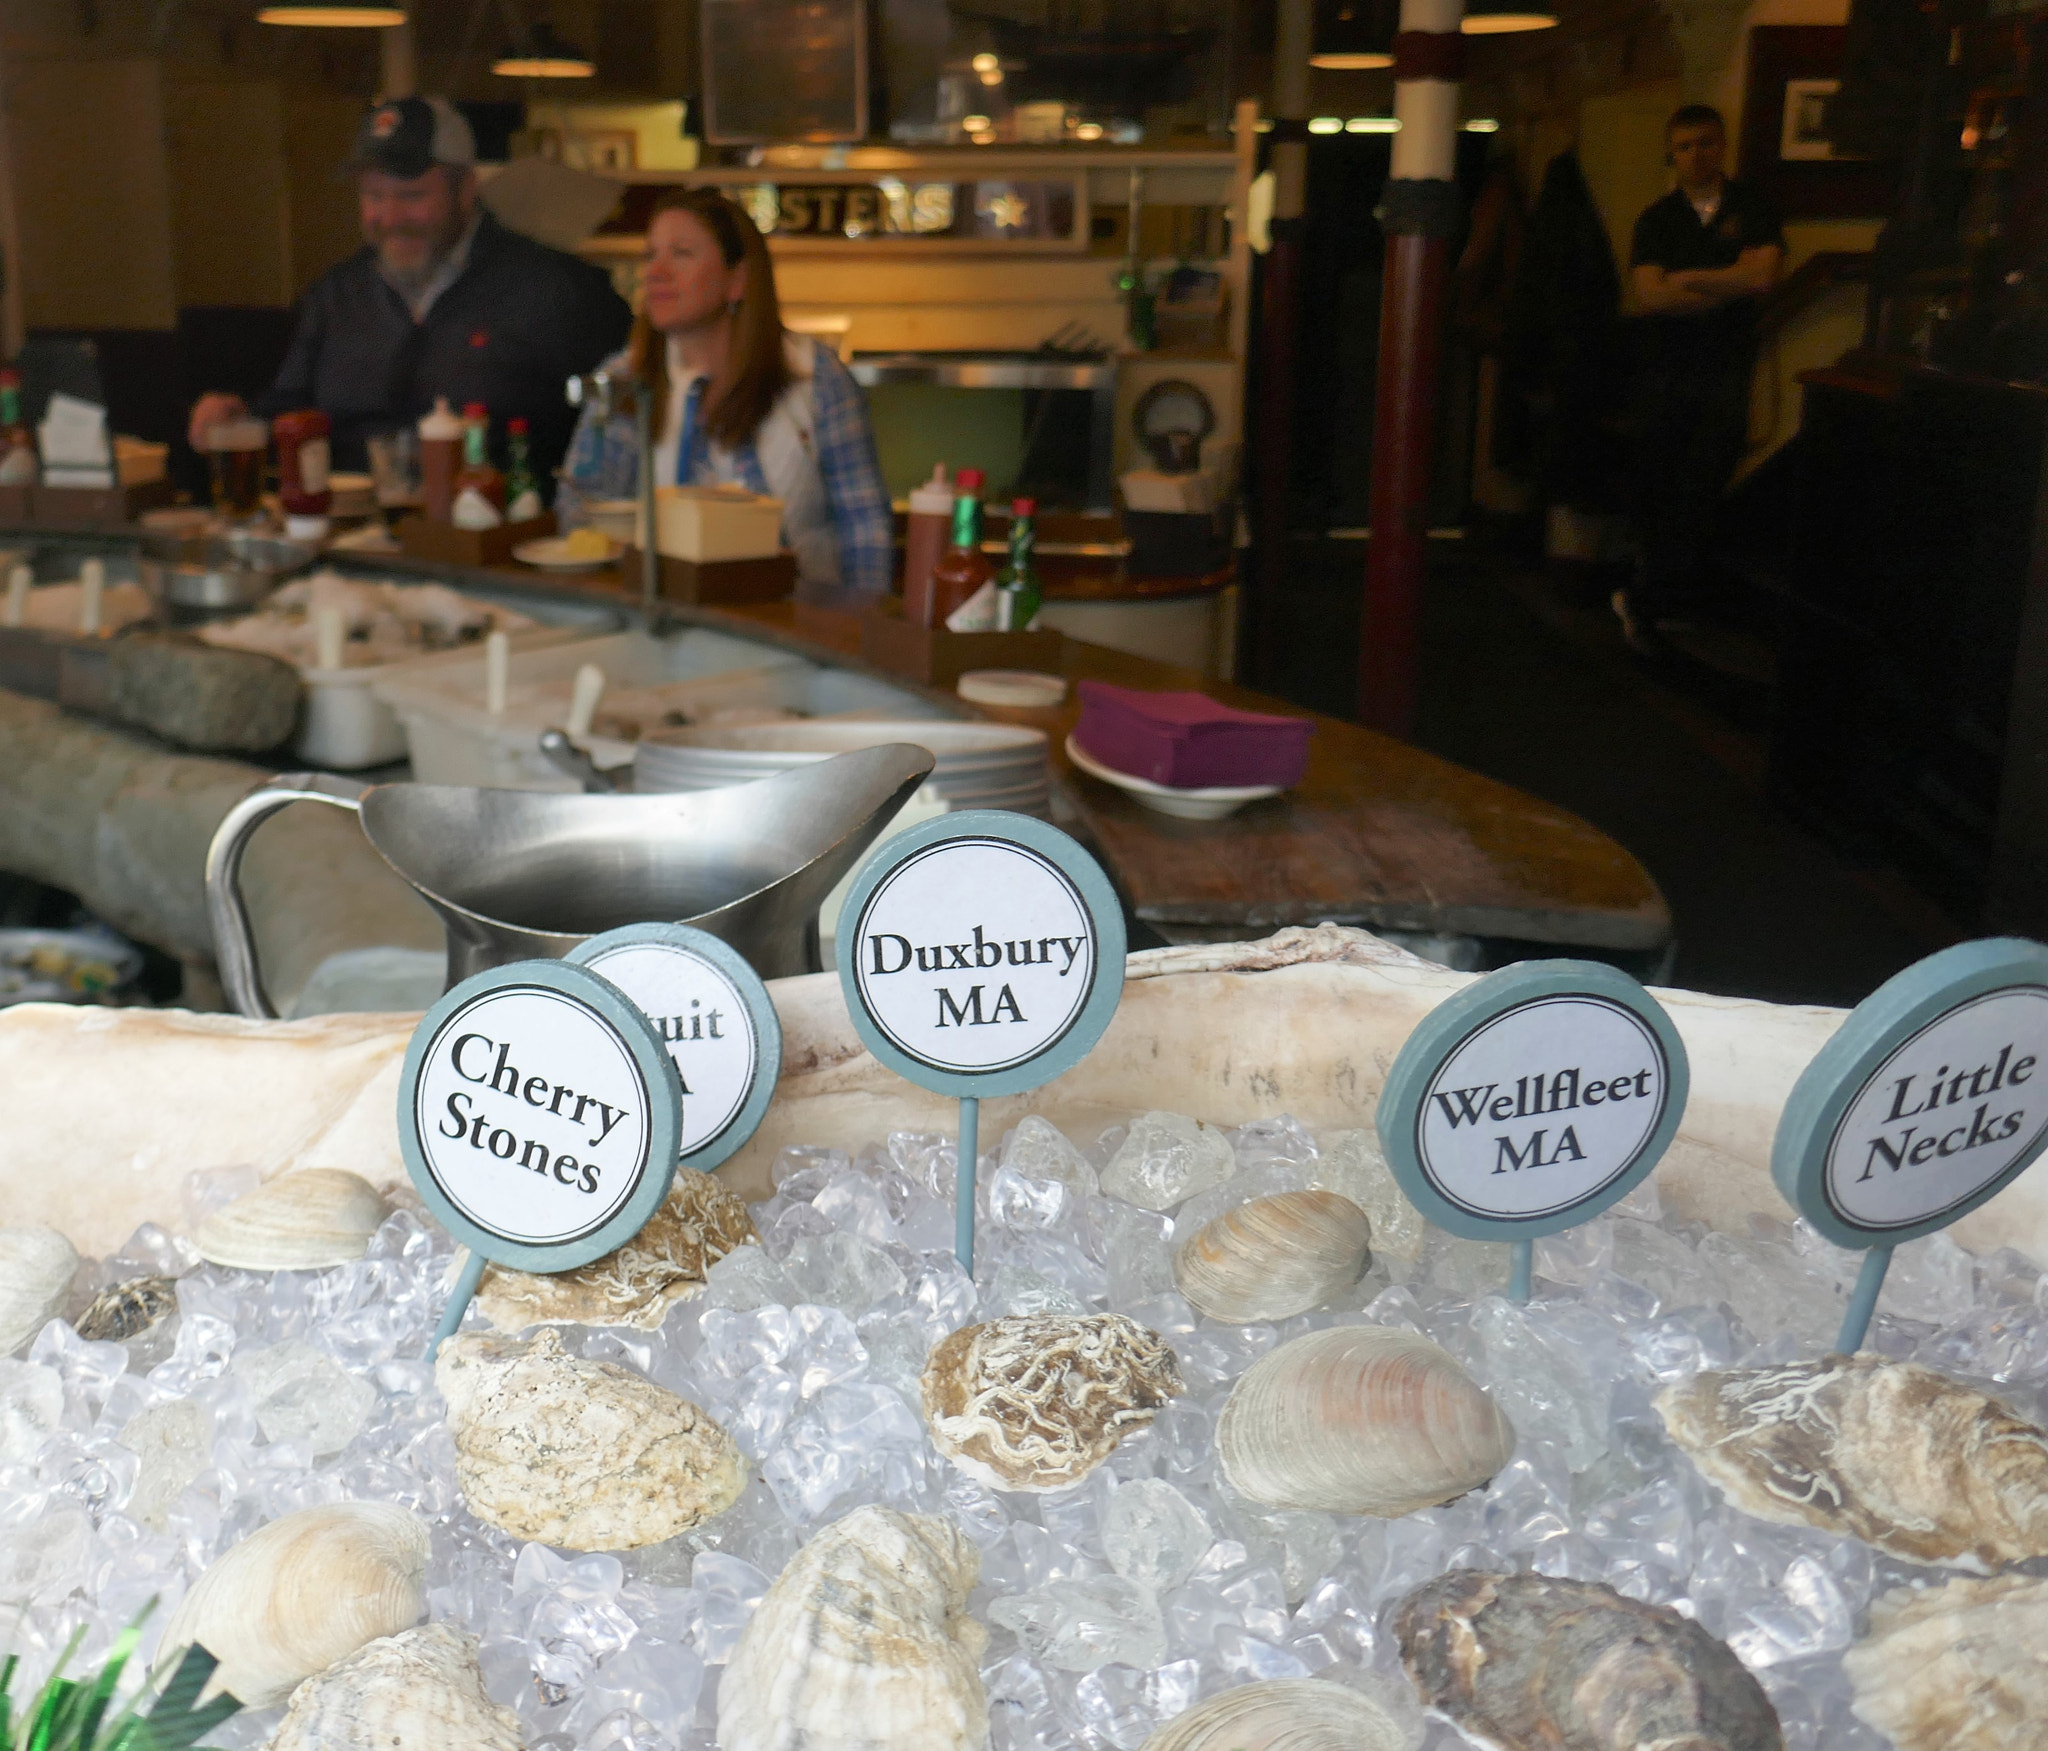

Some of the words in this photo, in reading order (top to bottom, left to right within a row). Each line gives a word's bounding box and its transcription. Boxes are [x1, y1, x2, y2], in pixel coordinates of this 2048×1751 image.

[868, 925, 1087, 977] Duxbury
[934, 983, 1028, 1028] MA
[451, 1033, 630, 1147] Cherry
[1431, 1067, 1652, 1130] Wellfleet
[1881, 1043, 2037, 1125] Little
[438, 1092, 601, 1195] Stones
[1491, 1124, 1588, 1175] MA
[1855, 1103, 2025, 1183] Necks
